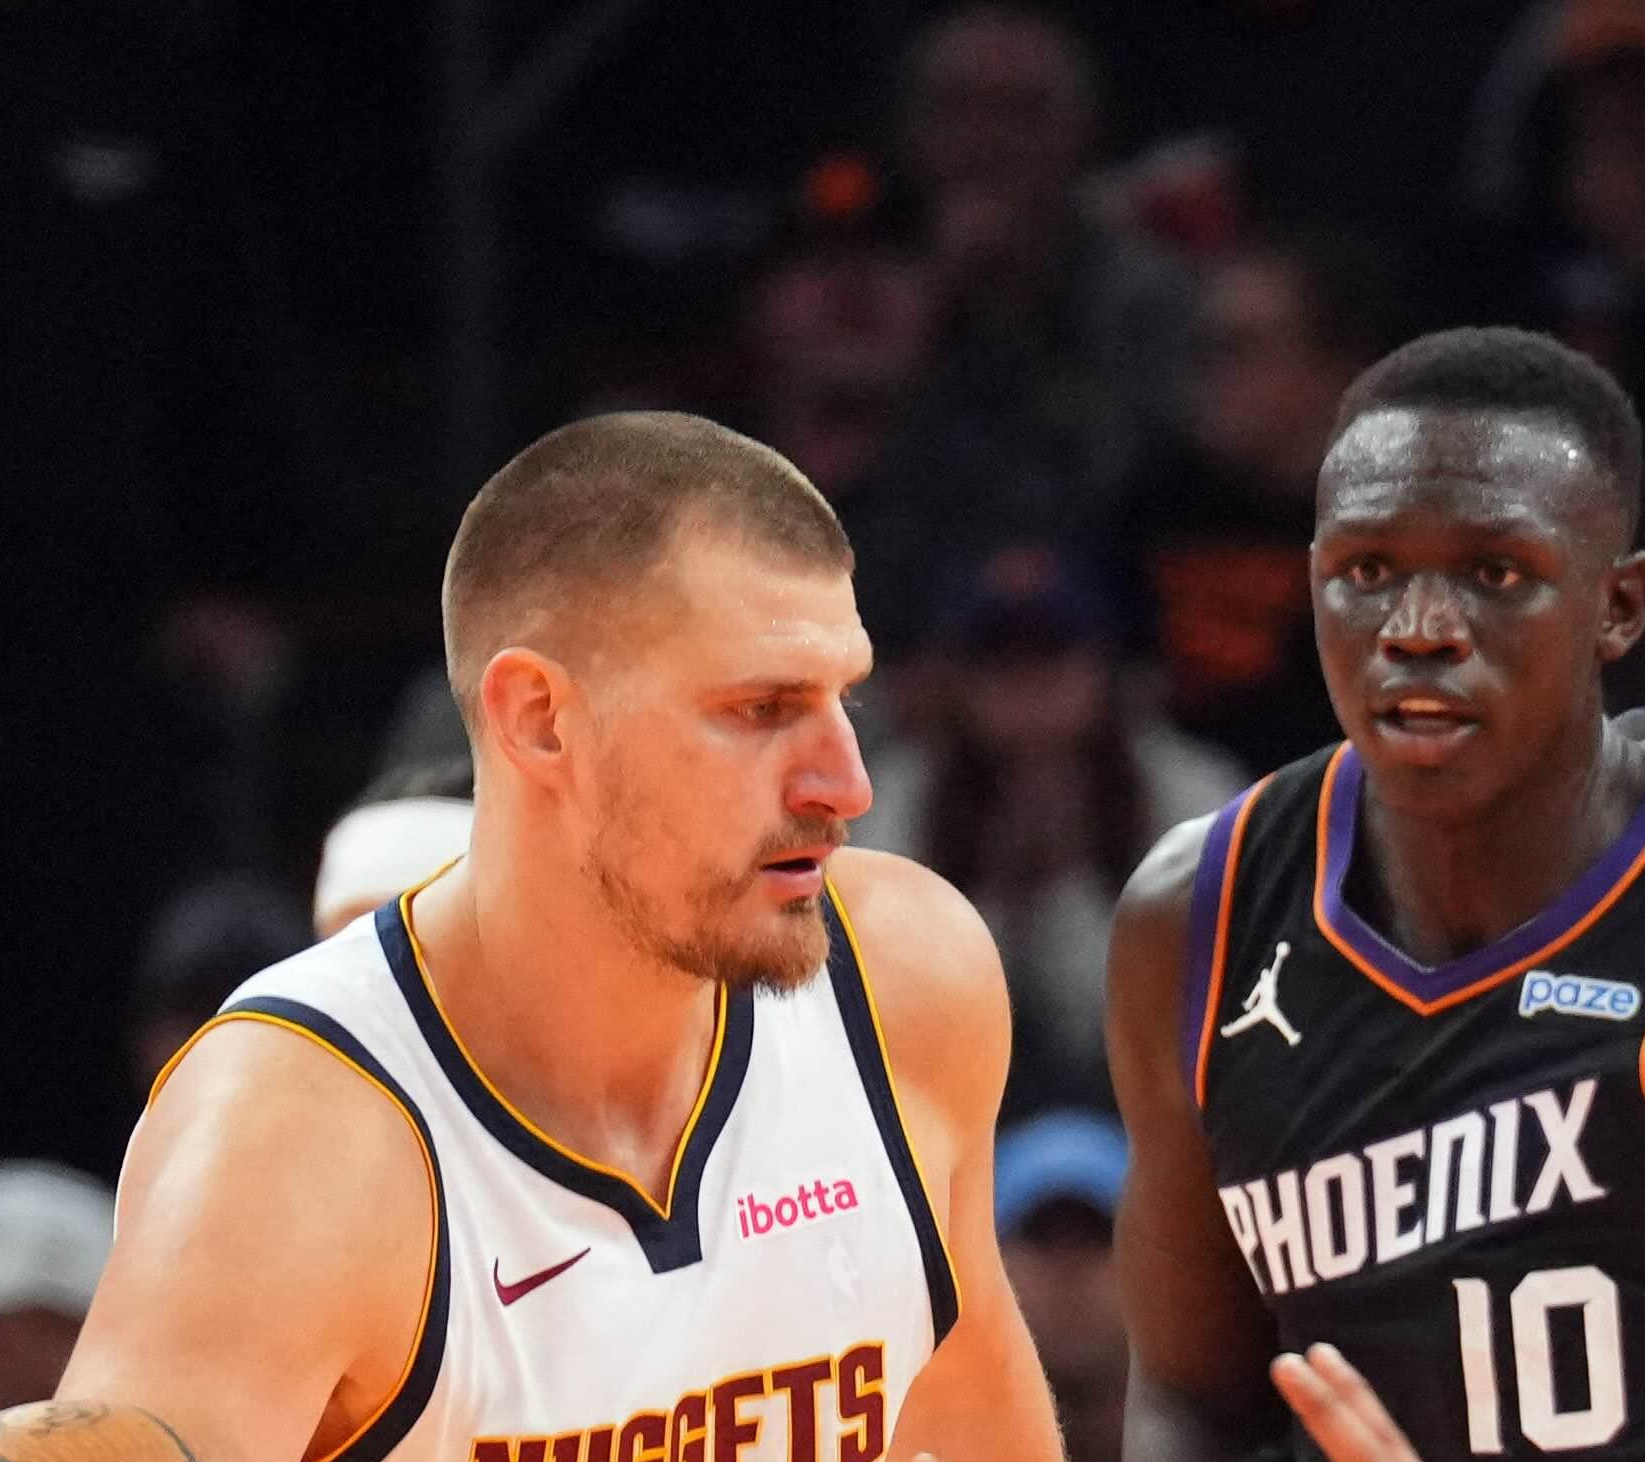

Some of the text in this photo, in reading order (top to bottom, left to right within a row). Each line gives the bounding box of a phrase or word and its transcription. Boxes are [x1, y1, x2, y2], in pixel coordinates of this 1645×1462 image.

[1524, 975, 1635, 1015] paze
[737, 1179, 858, 1238] ibotta
[1219, 1077, 1609, 1296] PHOENIX
[1452, 1265, 1627, 1455] 10
